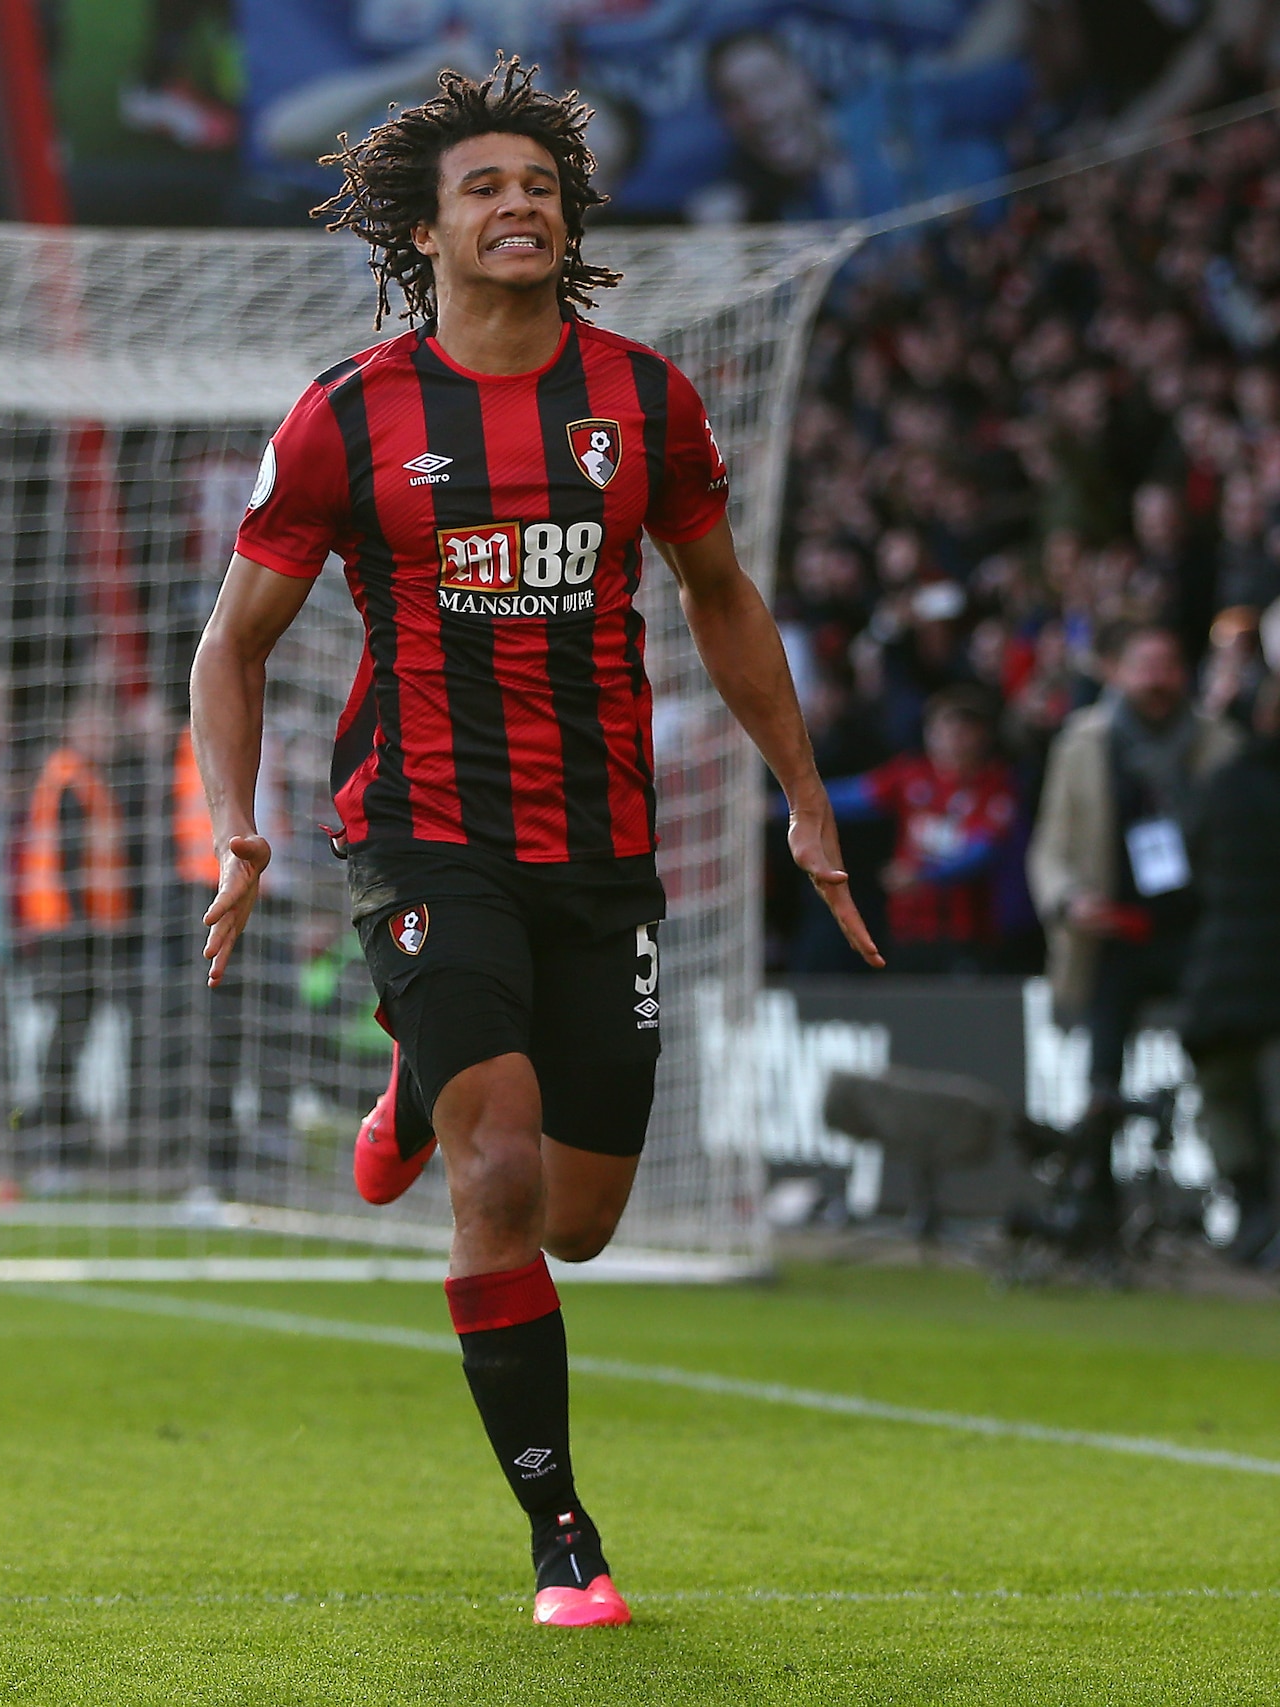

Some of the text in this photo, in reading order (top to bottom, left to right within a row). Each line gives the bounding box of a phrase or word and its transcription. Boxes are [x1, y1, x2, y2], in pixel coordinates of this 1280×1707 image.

[409, 473, 450, 487] umbro
[446, 521, 603, 588] M88
[438, 590, 559, 616] MANSION
[634, 921, 659, 995] 5
